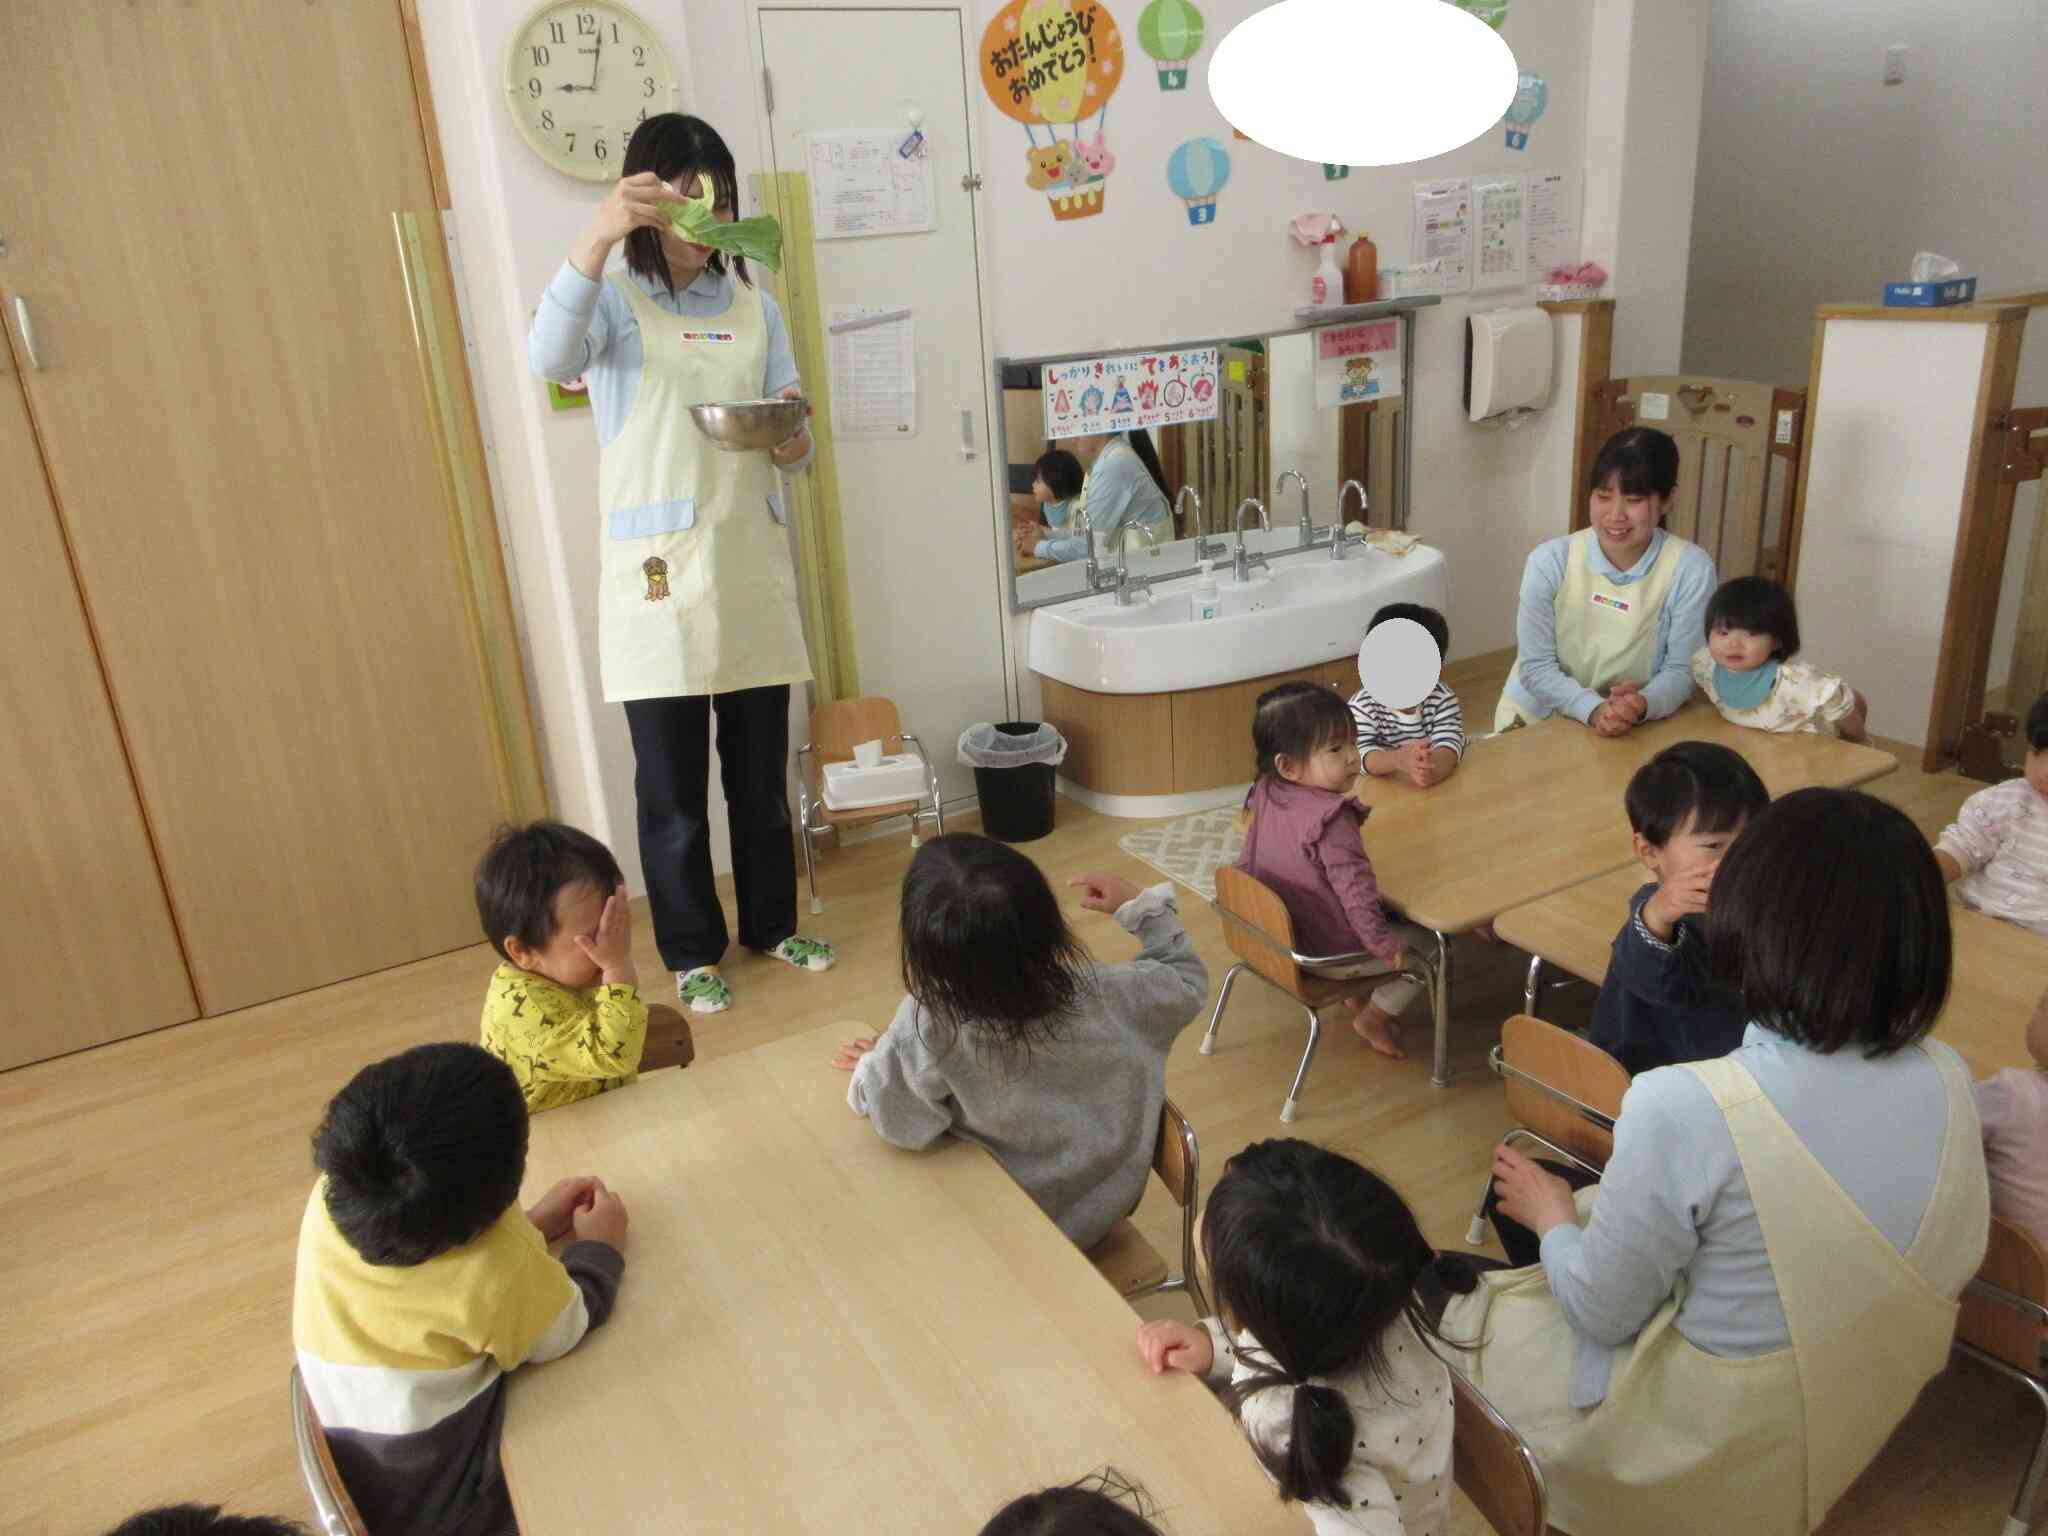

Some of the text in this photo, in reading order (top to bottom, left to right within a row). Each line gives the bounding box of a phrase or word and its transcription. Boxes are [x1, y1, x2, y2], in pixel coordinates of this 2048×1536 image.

[550, 22, 565, 44] 11
[576, 14, 596, 35] 12
[610, 23, 621, 44] 1
[990, 6, 1097, 78] おたんじょうび
[532, 46, 550, 67] 10
[632, 46, 645, 67] 2
[1009, 37, 1096, 104] おめでとう!
[1168, 71, 1179, 87] 4
[528, 78, 542, 99] 9
[643, 77, 655, 98] 3
[541, 110, 555, 131] 8
[565, 133, 576, 153] 7
[595, 139, 607, 161] 6
[1198, 207, 1207, 222] 3
[1081, 422, 1089, 433] 2
[1110, 419, 1117, 430] 3
